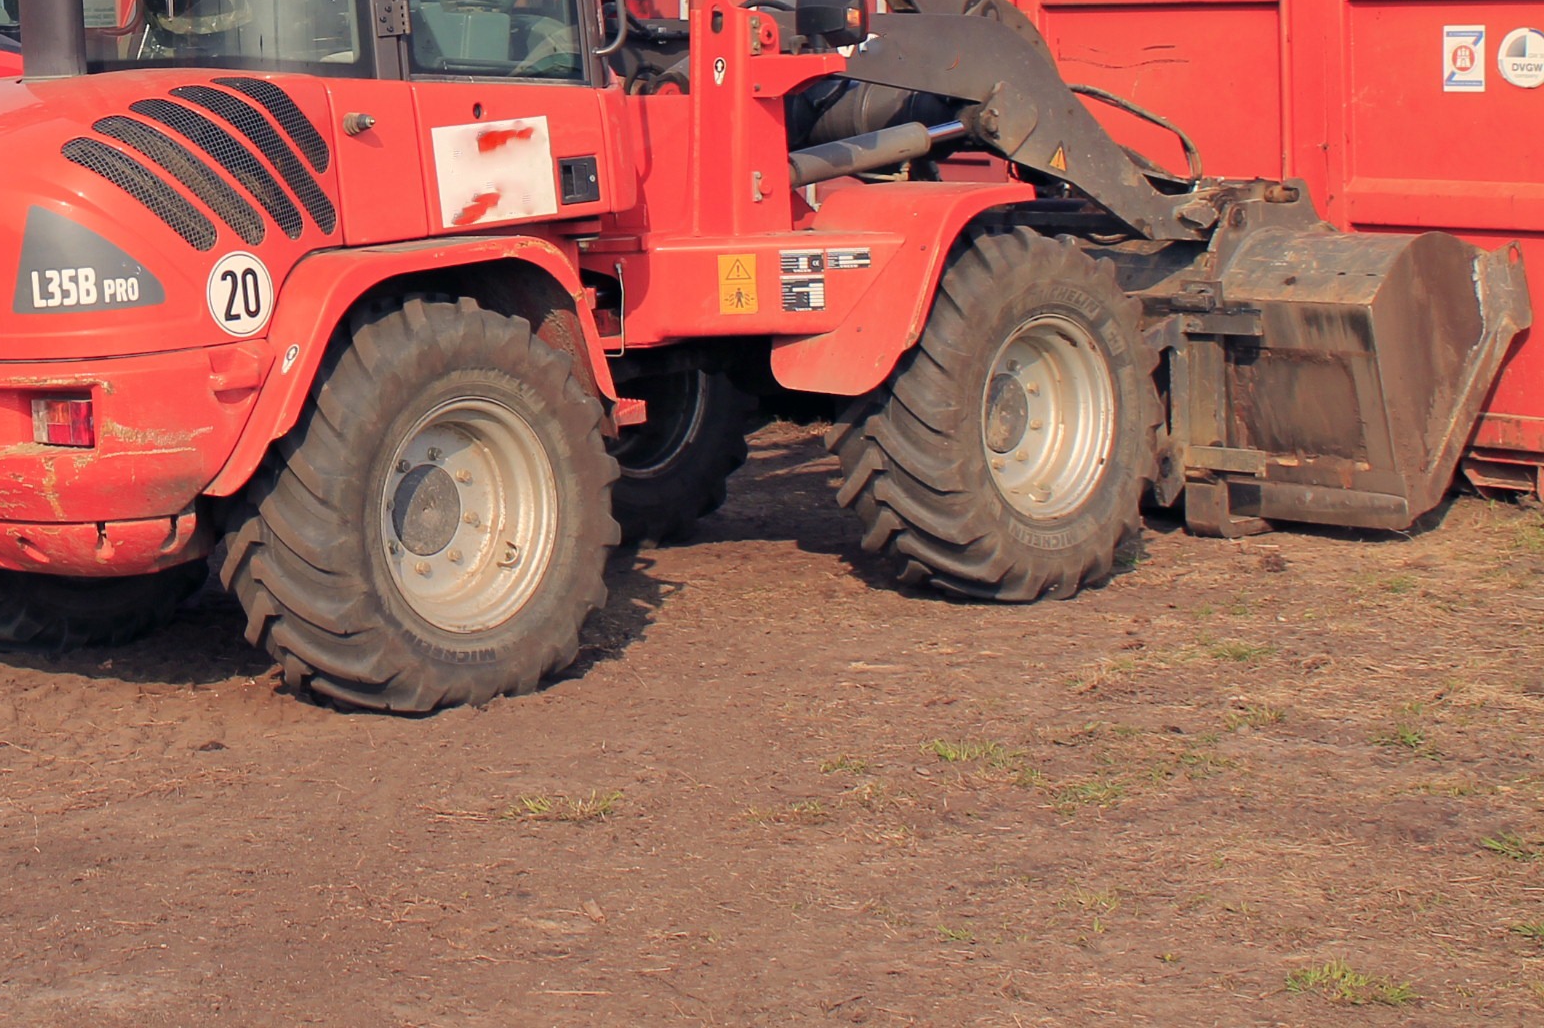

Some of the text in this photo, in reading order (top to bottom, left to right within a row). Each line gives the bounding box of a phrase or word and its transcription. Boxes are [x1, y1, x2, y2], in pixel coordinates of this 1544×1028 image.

[1511, 62, 1544, 72] DVGW
[31, 267, 140, 308] L35B PRO
[220, 267, 262, 322] 20
